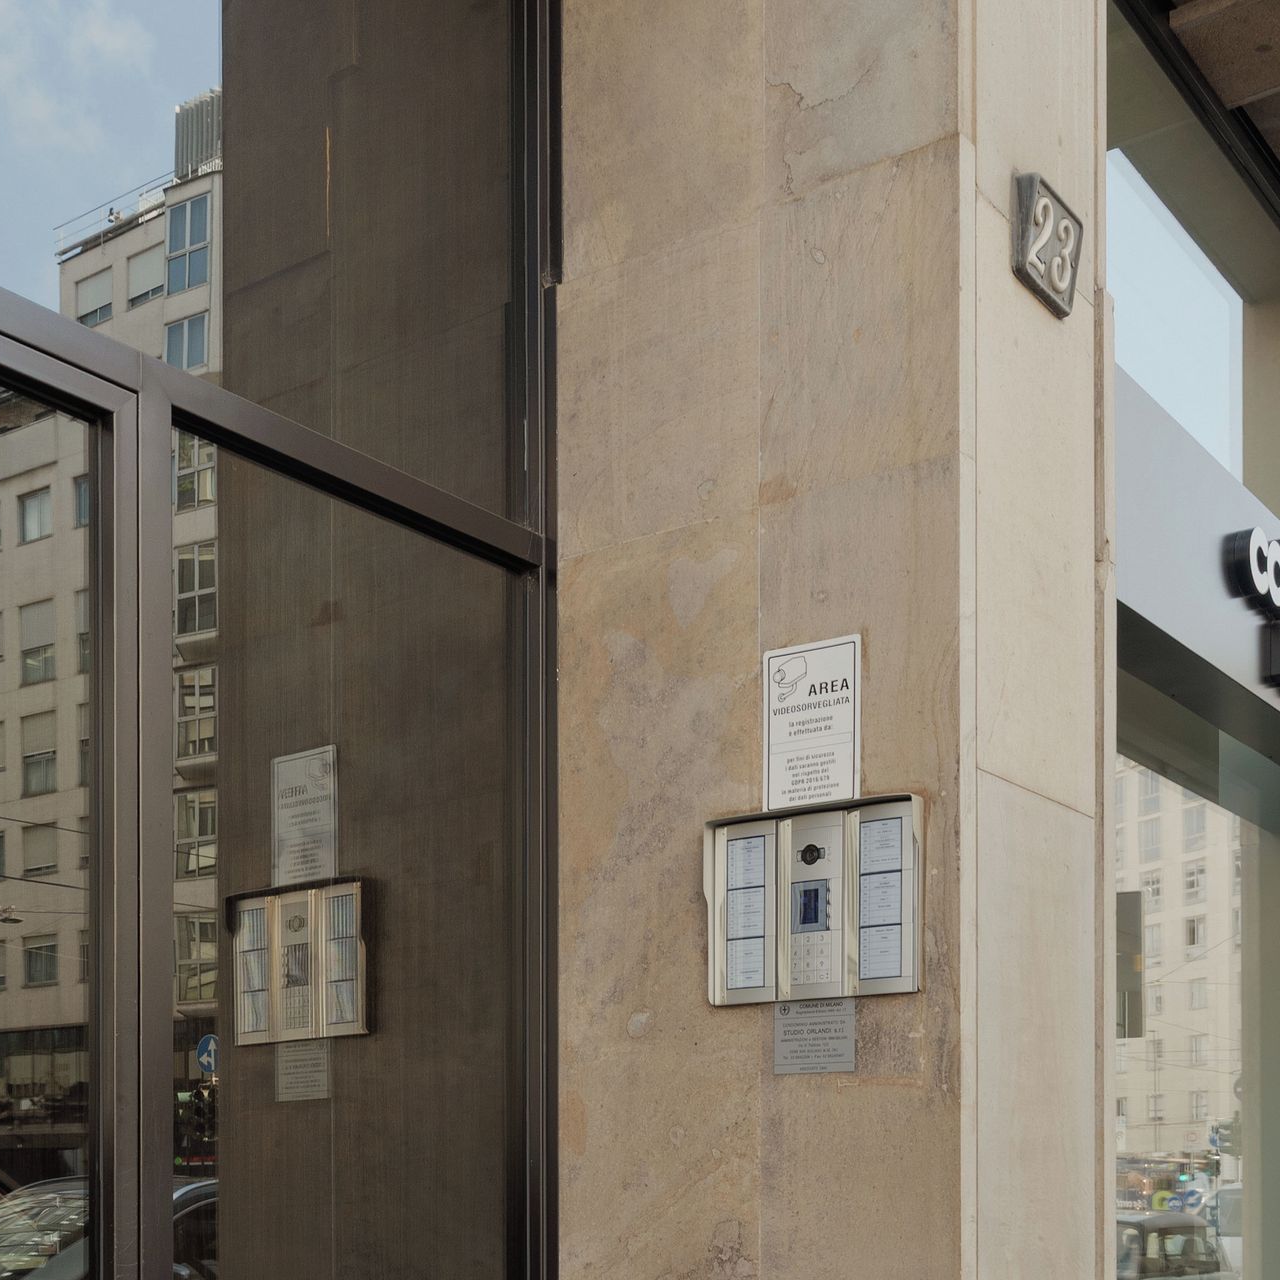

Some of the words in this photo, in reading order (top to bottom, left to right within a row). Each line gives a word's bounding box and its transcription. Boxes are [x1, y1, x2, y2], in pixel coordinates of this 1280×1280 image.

[1026, 196, 1075, 294] 23
[808, 678, 850, 696] AREA
[773, 696, 850, 717] VIDEOSORVEGLIATA
[789, 720, 795, 728] la
[795, 715, 833, 728] registrazione
[793, 725, 822, 736] effettuata
